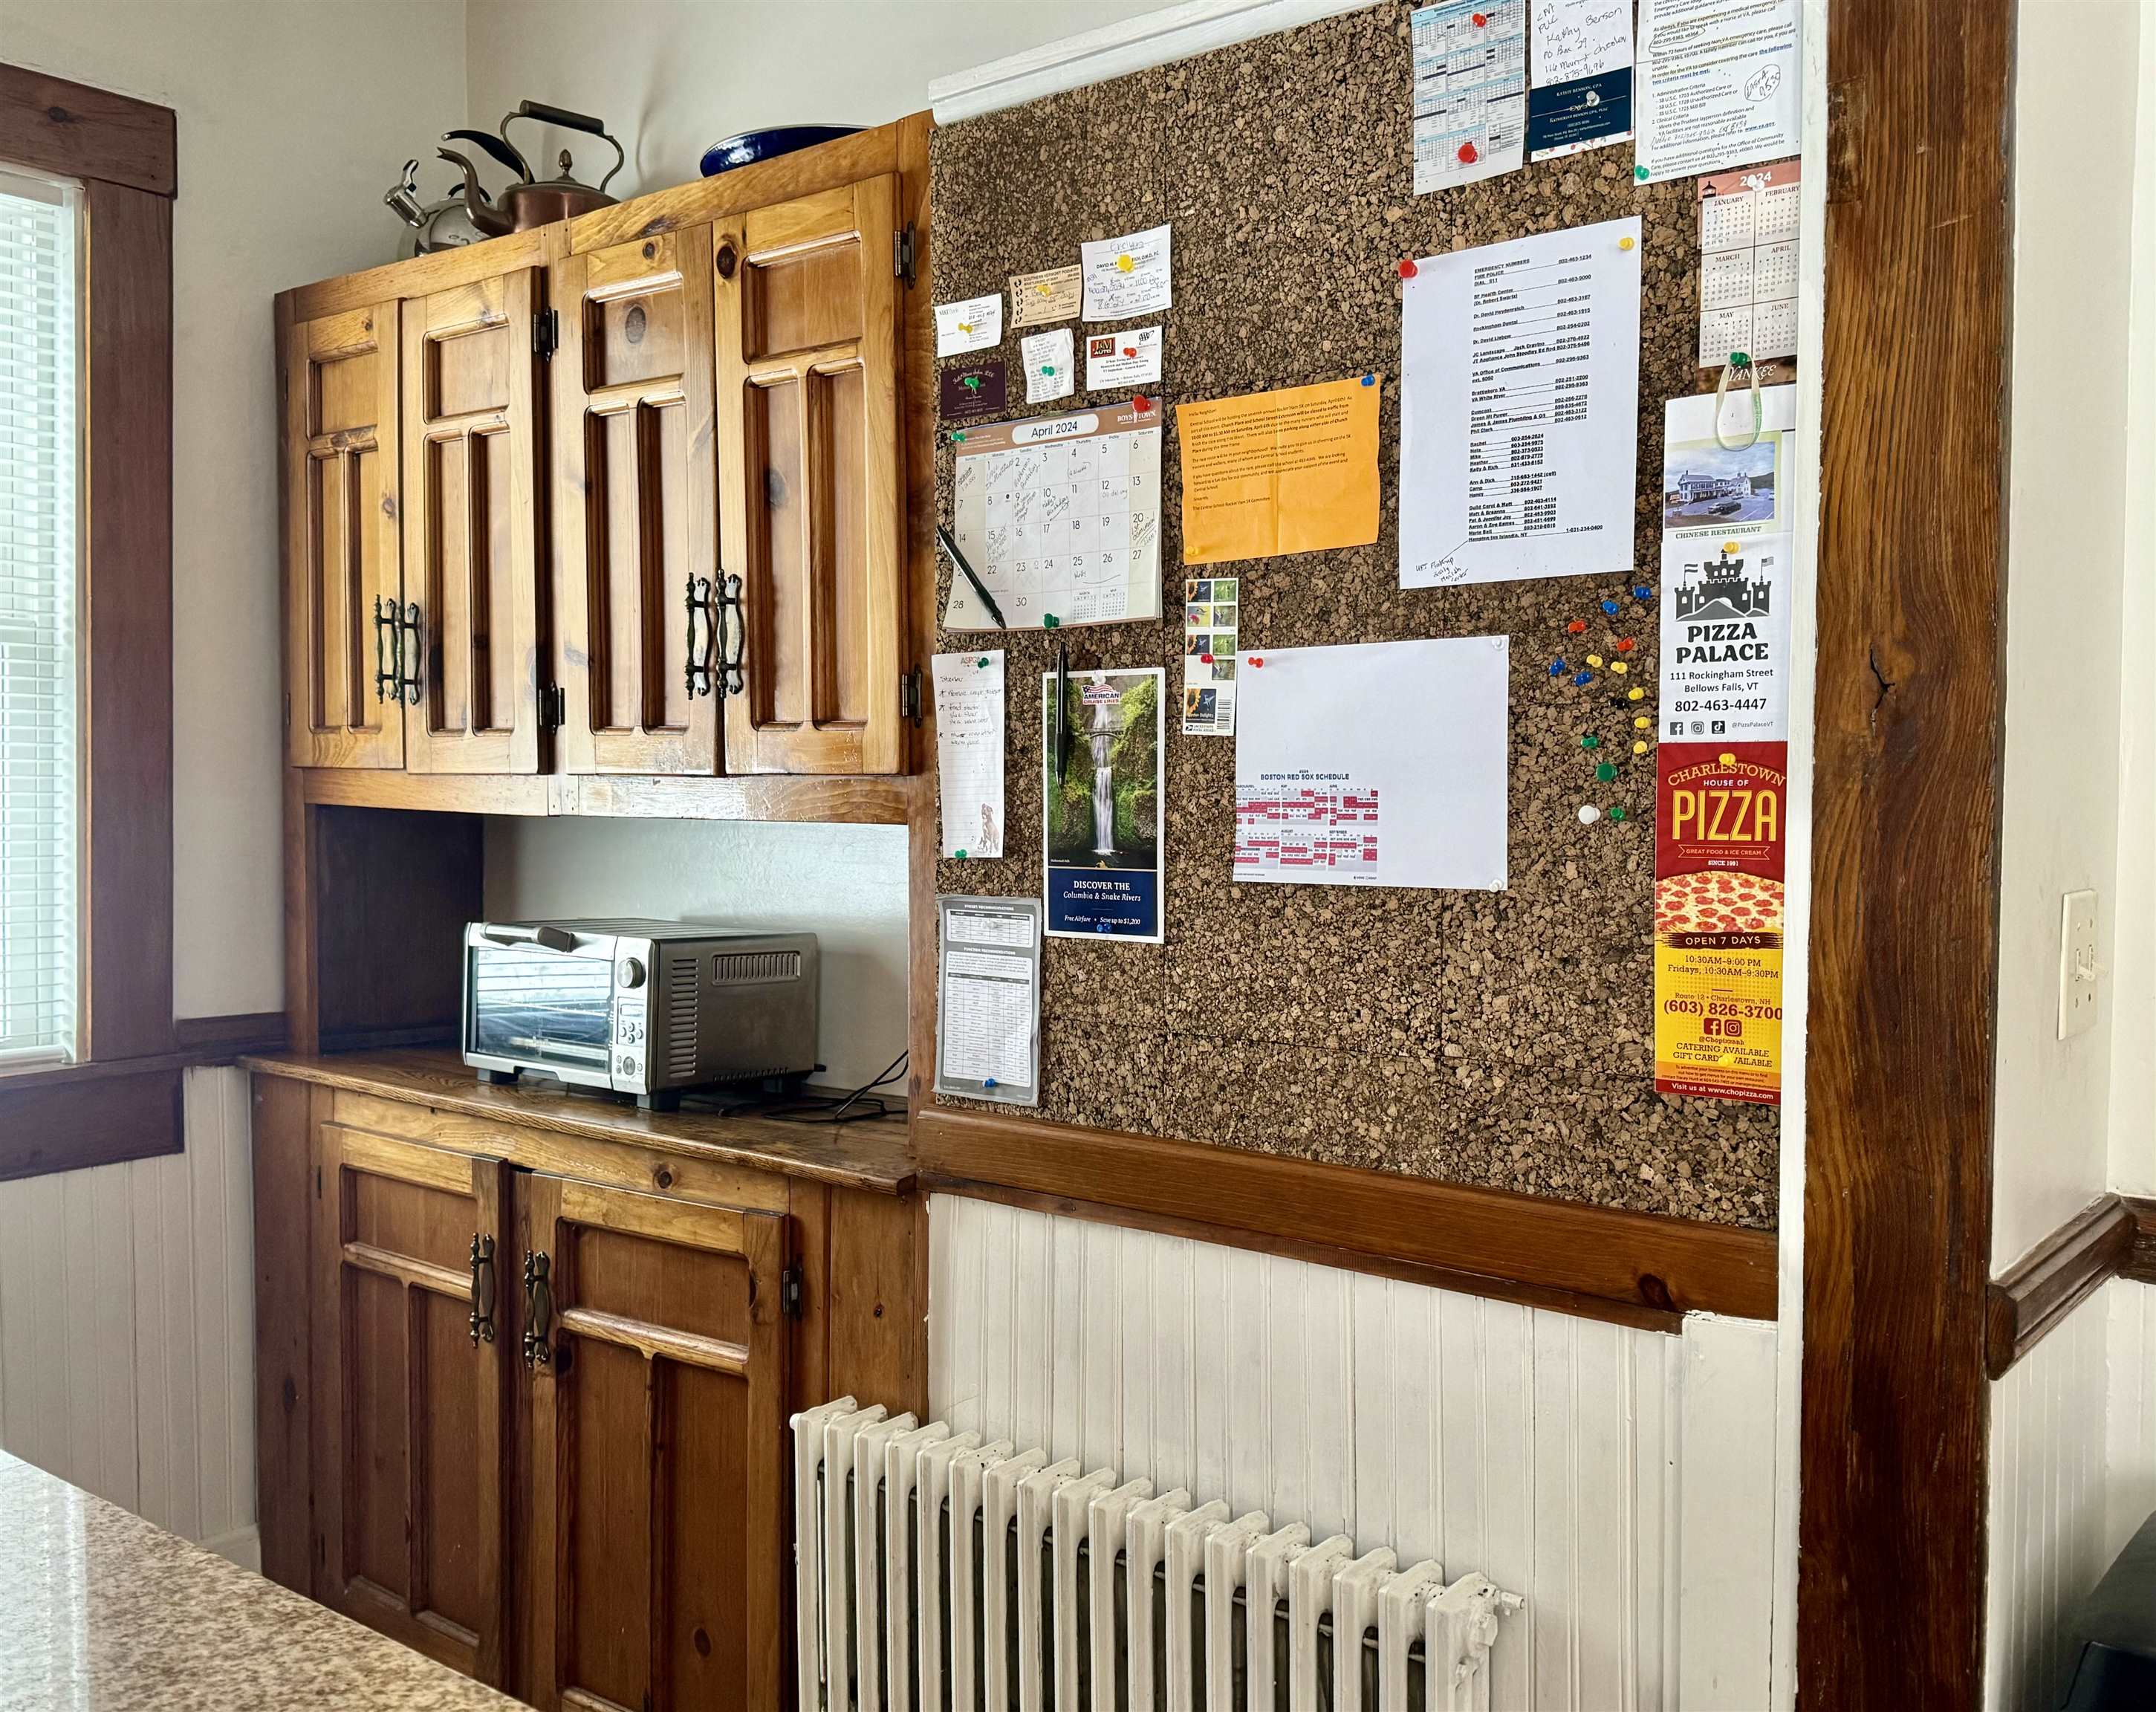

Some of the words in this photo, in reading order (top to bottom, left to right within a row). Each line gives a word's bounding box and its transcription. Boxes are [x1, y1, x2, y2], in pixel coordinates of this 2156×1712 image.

[1731, 5, 1748, 14] medical
[1751, 7, 1766, 16] please
[1767, 24, 1783, 33] please
[1718, 54, 1738, 65] covering
[1657, 85, 1688, 97] Administrative
[1689, 82, 1705, 90] Criteria
[1690, 87, 1715, 97] Authorized
[1757, 132, 1783, 143] Community
[1714, 196, 1744, 206] JANUARY
[1765, 185, 1801, 197] FEBRUARY
[1715, 254, 1740, 263] MARCH
[1771, 245, 1791, 254] APRIL
[1475, 265, 1504, 273] EMERGENCY
[1506, 259, 1530, 268] NUMBERS
[1770, 303, 1789, 311] JUNE
[1138, 410, 1156, 419] TOWN
[1031, 424, 1053, 438] April
[1056, 421, 1077, 434] 2024
[1103, 444, 1107, 453] 5
[1133, 440, 1138, 449] 6
[1042, 453, 1048, 461] 3
[1071, 449, 1076, 457] 4
[988, 461, 990, 470] 1
[1016, 458, 1020, 467] 2
[1103, 480, 1109, 490] 12
[1132, 476, 1140, 486] 13
[1043, 488, 1051, 497] 10
[1072, 484, 1077, 493] 11
[988, 496, 993, 505] 8
[1016, 493, 1020, 501] 9
[958, 500, 963, 508] 7
[1103, 517, 1110, 526] 19
[1133, 513, 1143, 522] 20
[1073, 520, 1080, 529] 18
[1044, 525, 1050, 534] 17
[1675, 531, 1709, 539] CHINESE
[1711, 526, 1762, 536] RESTAURANT
[959, 534, 966, 542] 14
[988, 531, 996, 539] 15
[1103, 554, 1113, 562] 26
[1133, 550, 1141, 560] 27
[1045, 560, 1053, 569] 24
[1073, 556, 1082, 565] 25
[987, 565, 996, 574] 22
[1016, 562, 1026, 571] 23
[953, 600, 964, 609] 28
[1016, 597, 1027, 606] 30
[1687, 623, 1757, 643] PIZZA
[1676, 643, 1769, 664] PALACE
[1689, 670, 1744, 681] Rockingham
[1746, 669, 1773, 677] Street
[1684, 684, 1719, 693] Bellows
[1721, 683, 1744, 692] Falls,
[1675, 698, 1767, 712] 802-463-4447
[1668, 763, 1786, 787] CHARLESTOWN
[1672, 790, 1777, 841] PIZZA
[1074, 881, 1112, 889] DISCOVER
[1114, 882, 1130, 890] THE
[1063, 891, 1093, 899] Columbia
[1685, 937, 1716, 946] OPEN
[1731, 936, 1761, 944] DAYS
[1668, 964, 1701, 975] Fridays,
[1711, 995, 1757, 1005] Charlestown,
[1663, 1000, 1704, 1014] (603)
[1708, 1003, 1782, 1020] 826-3700
[1699, 1036, 1744, 1045] @Chopizzanh
[1676, 1043, 1721, 1052] CATERING
[1723, 1048, 1769, 1057] AVAILABLE
[1672, 1083, 1687, 1091] Visit
[1707, 1086, 1773, 1100] www.chopizza.com
